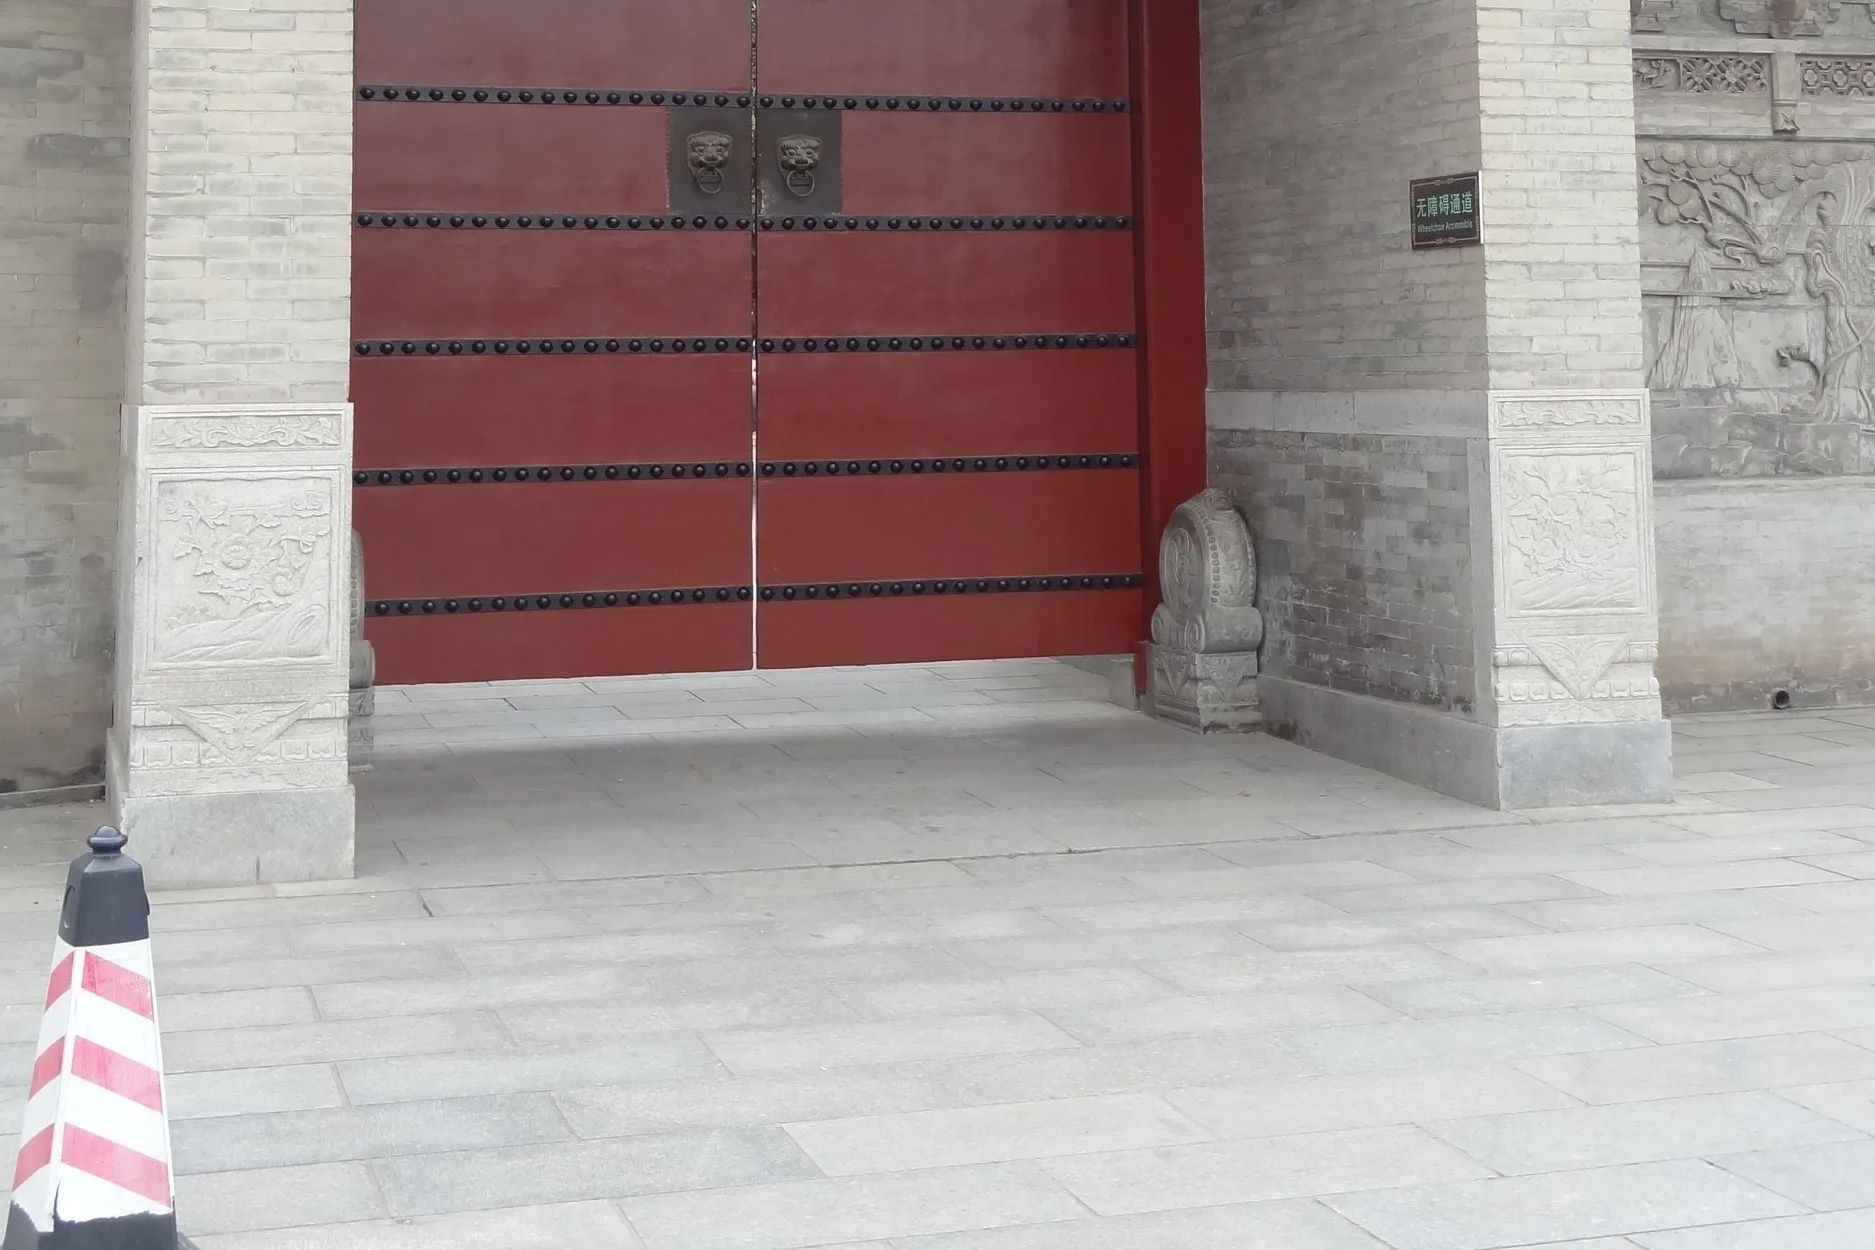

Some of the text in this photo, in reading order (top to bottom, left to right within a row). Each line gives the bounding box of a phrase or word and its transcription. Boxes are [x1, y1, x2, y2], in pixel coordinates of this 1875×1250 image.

[1416, 191, 1473, 218] 无障碍通道
[1445, 219, 1473, 230] Accessible
